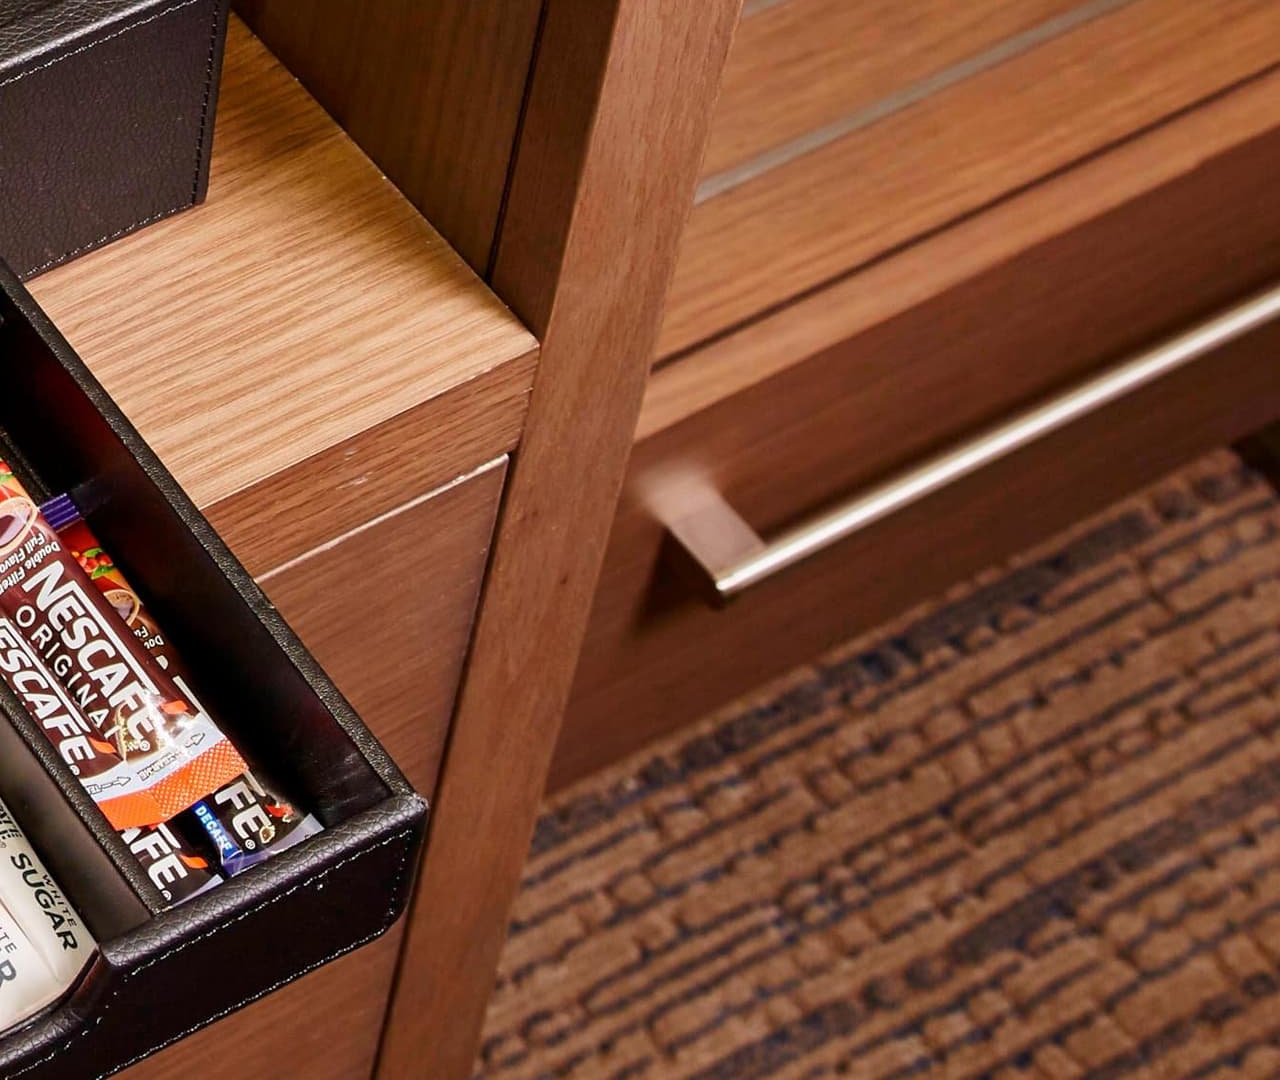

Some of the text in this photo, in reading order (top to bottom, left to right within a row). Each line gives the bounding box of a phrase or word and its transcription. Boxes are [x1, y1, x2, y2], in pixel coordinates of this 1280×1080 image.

[24, 532, 45, 554] Full
[24, 541, 61, 569] Double
[11, 853, 78, 950] SUGAR
[42, 874, 77, 927] WHITE
